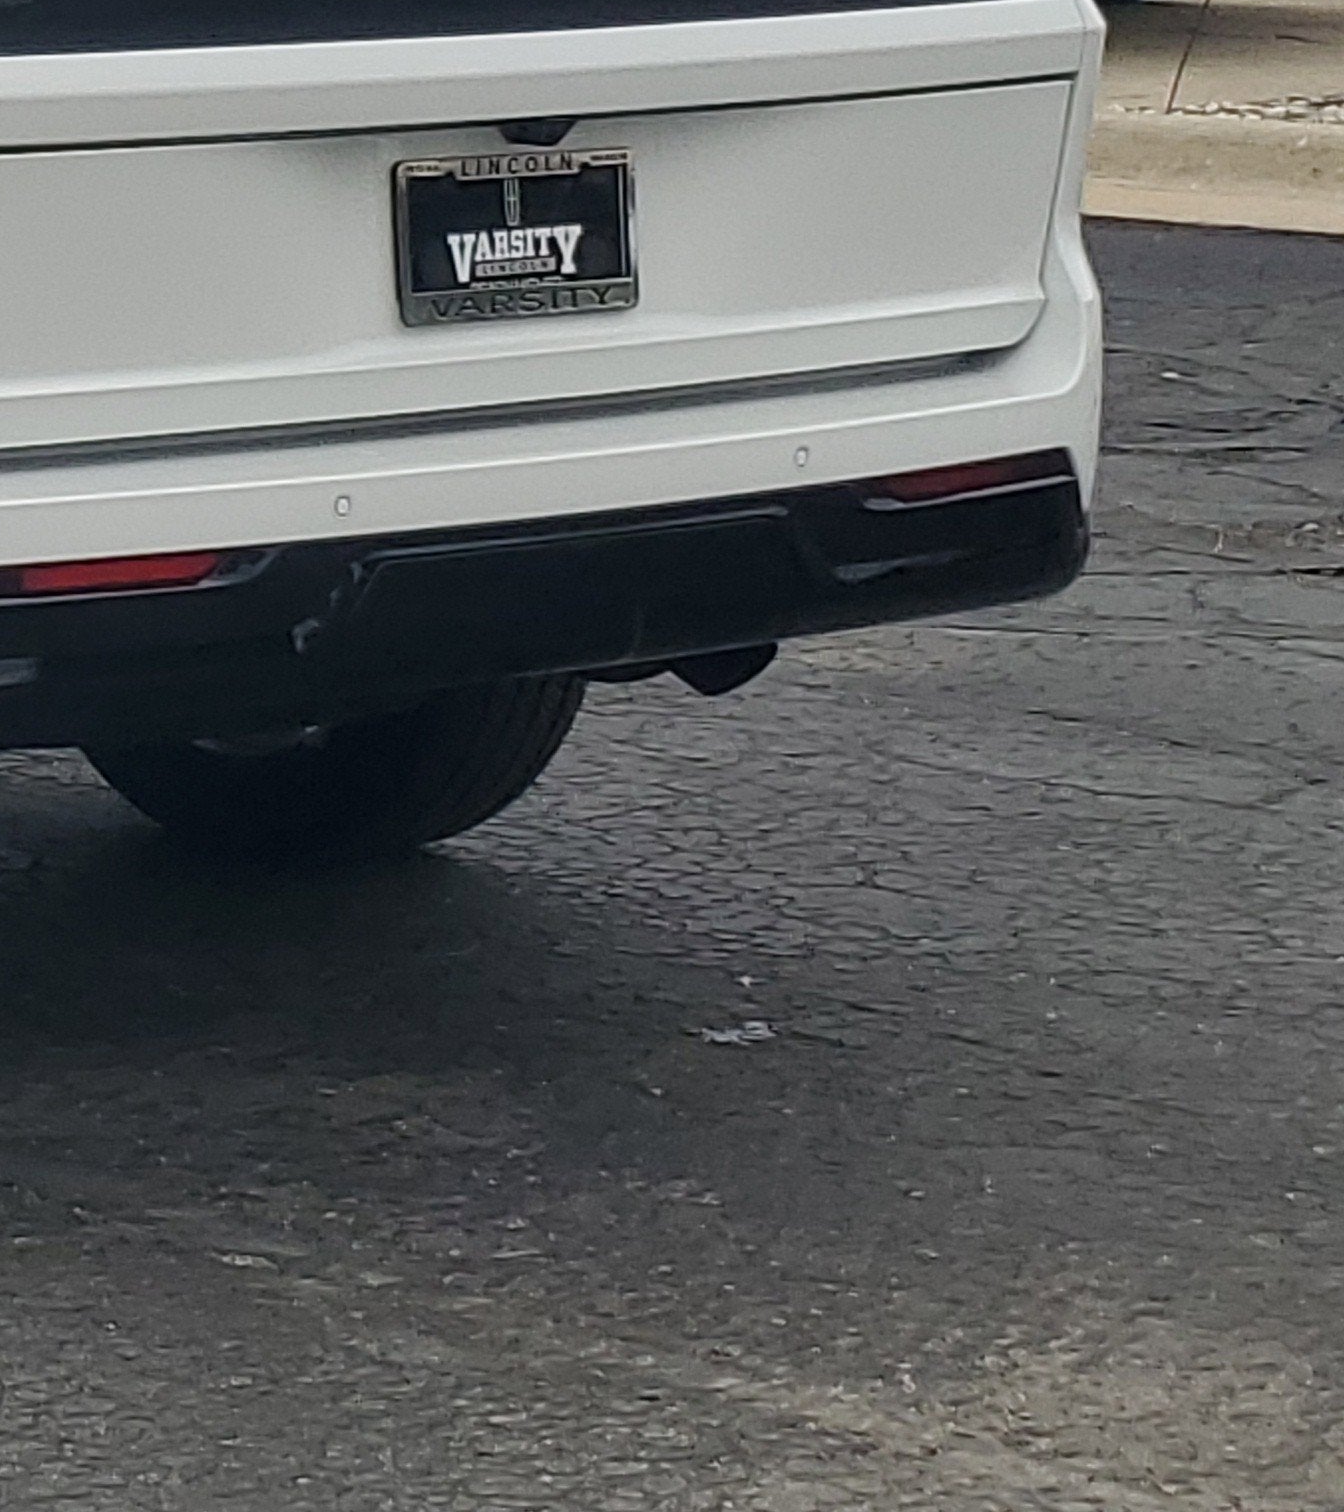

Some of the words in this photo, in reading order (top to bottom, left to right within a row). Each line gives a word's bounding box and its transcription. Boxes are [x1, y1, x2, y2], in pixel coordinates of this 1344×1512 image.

[460, 153, 574, 178] LINCOLN
[447, 224, 583, 284] VARSITY
[481, 260, 551, 276] LINCOLN
[429, 285, 614, 318] VARSITY
